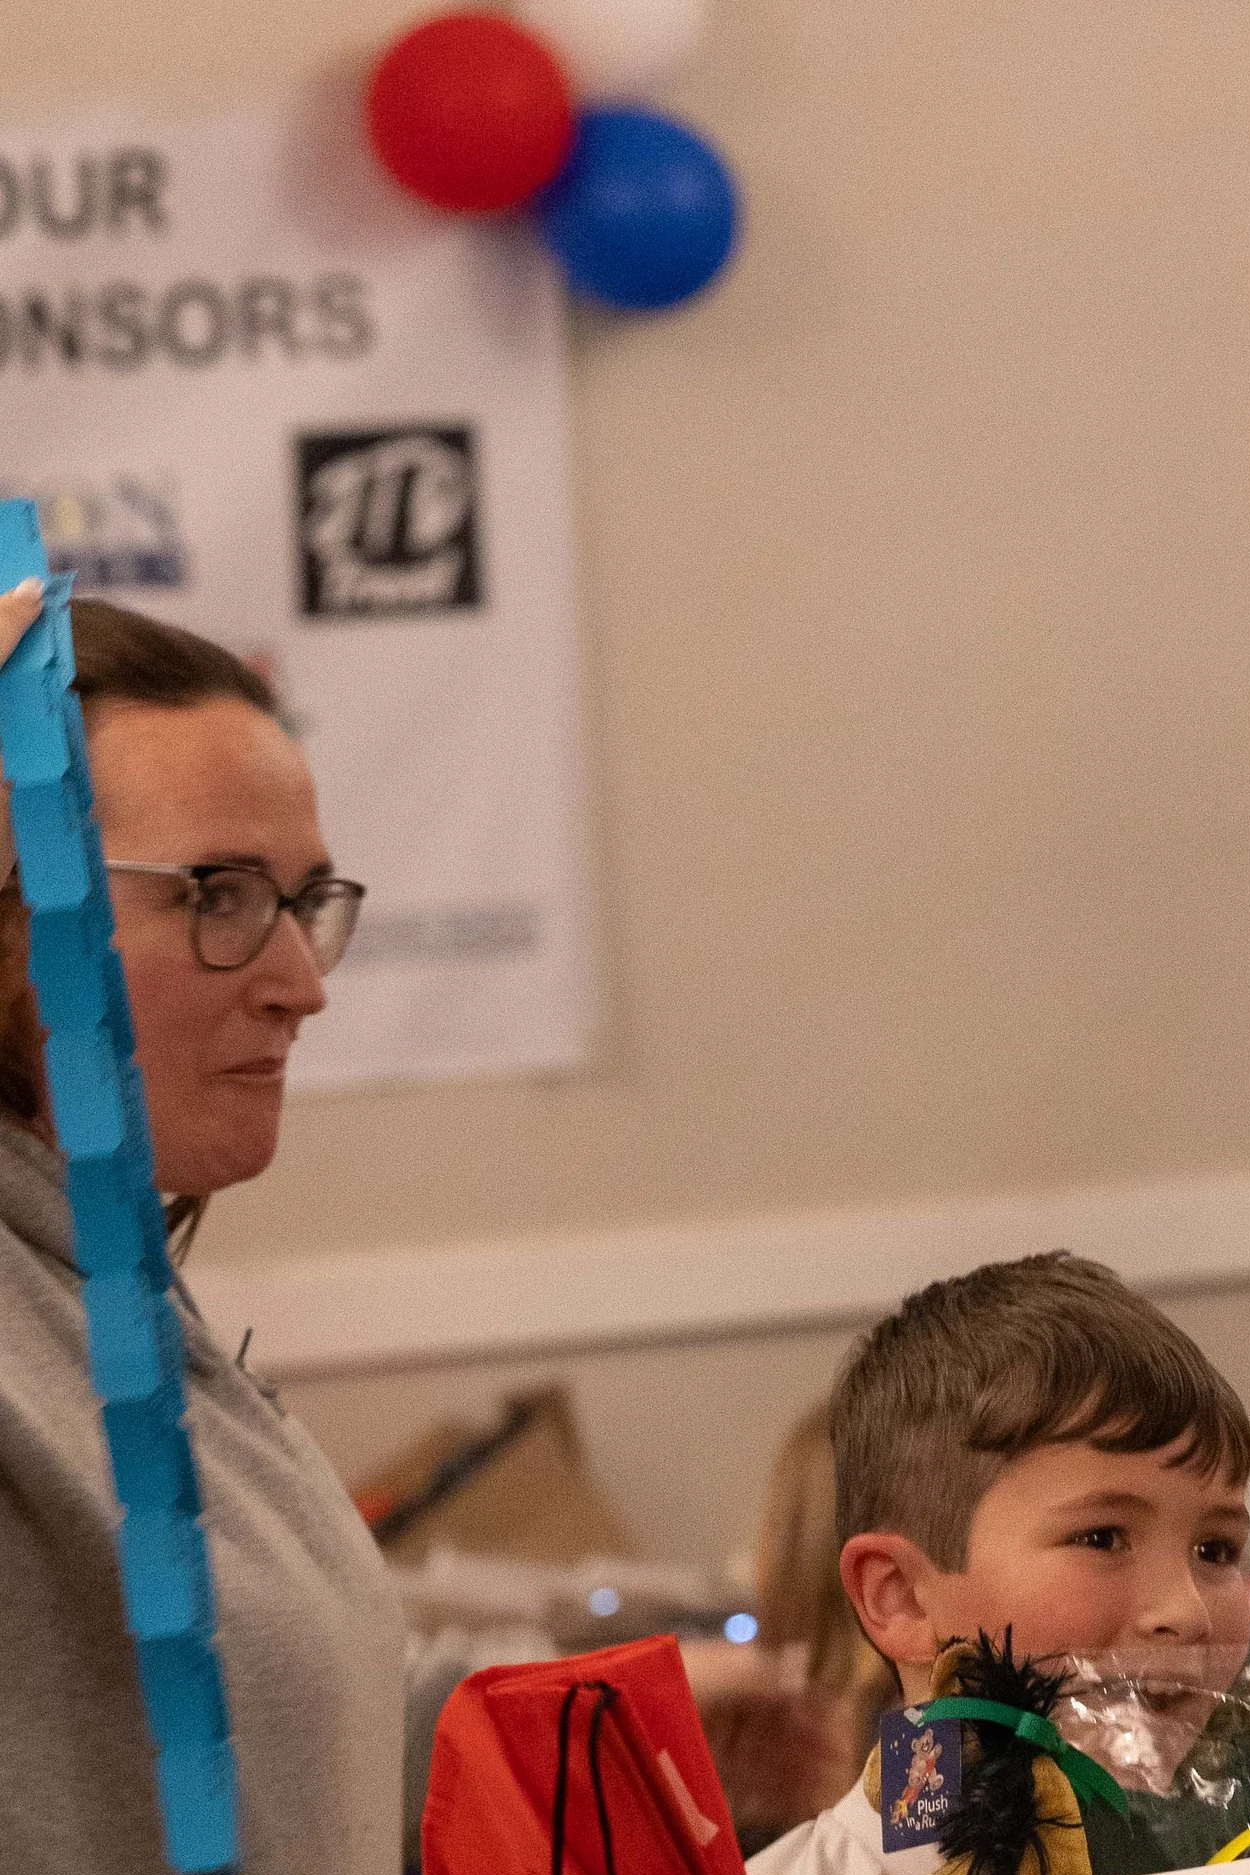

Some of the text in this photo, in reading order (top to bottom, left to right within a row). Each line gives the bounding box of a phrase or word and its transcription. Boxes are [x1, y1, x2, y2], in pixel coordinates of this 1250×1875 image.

[0, 149, 169, 242] UR
[0, 273, 377, 372] NSORS
[918, 1794, 948, 1815] Plush
[922, 1814, 936, 1829] Ru
